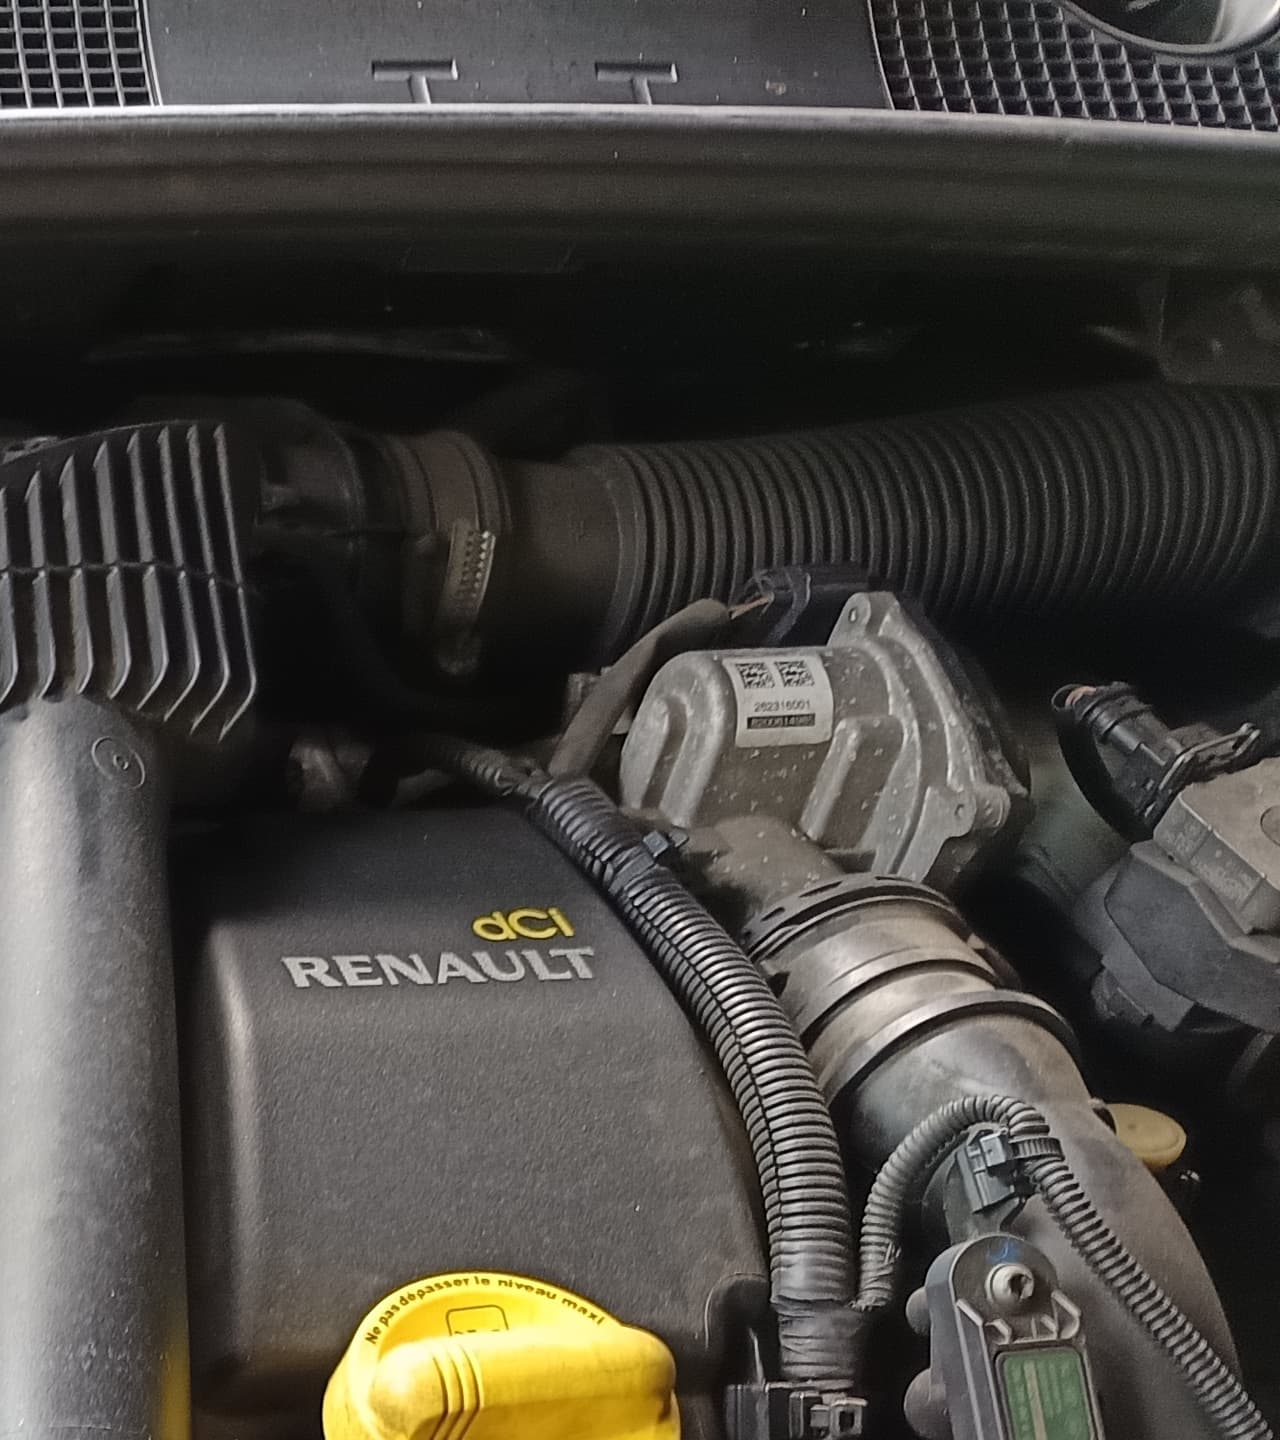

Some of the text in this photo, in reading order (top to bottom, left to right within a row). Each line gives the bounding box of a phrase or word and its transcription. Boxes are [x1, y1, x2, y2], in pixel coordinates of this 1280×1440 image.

[281, 947, 595, 988] RENAULT
[365, 1326, 382, 1345] Ne
[379, 1304, 401, 1327] pas
[474, 1276, 491, 1286] le
[497, 1278, 557, 1300] niveau
[561, 1297, 606, 1325] maxi
